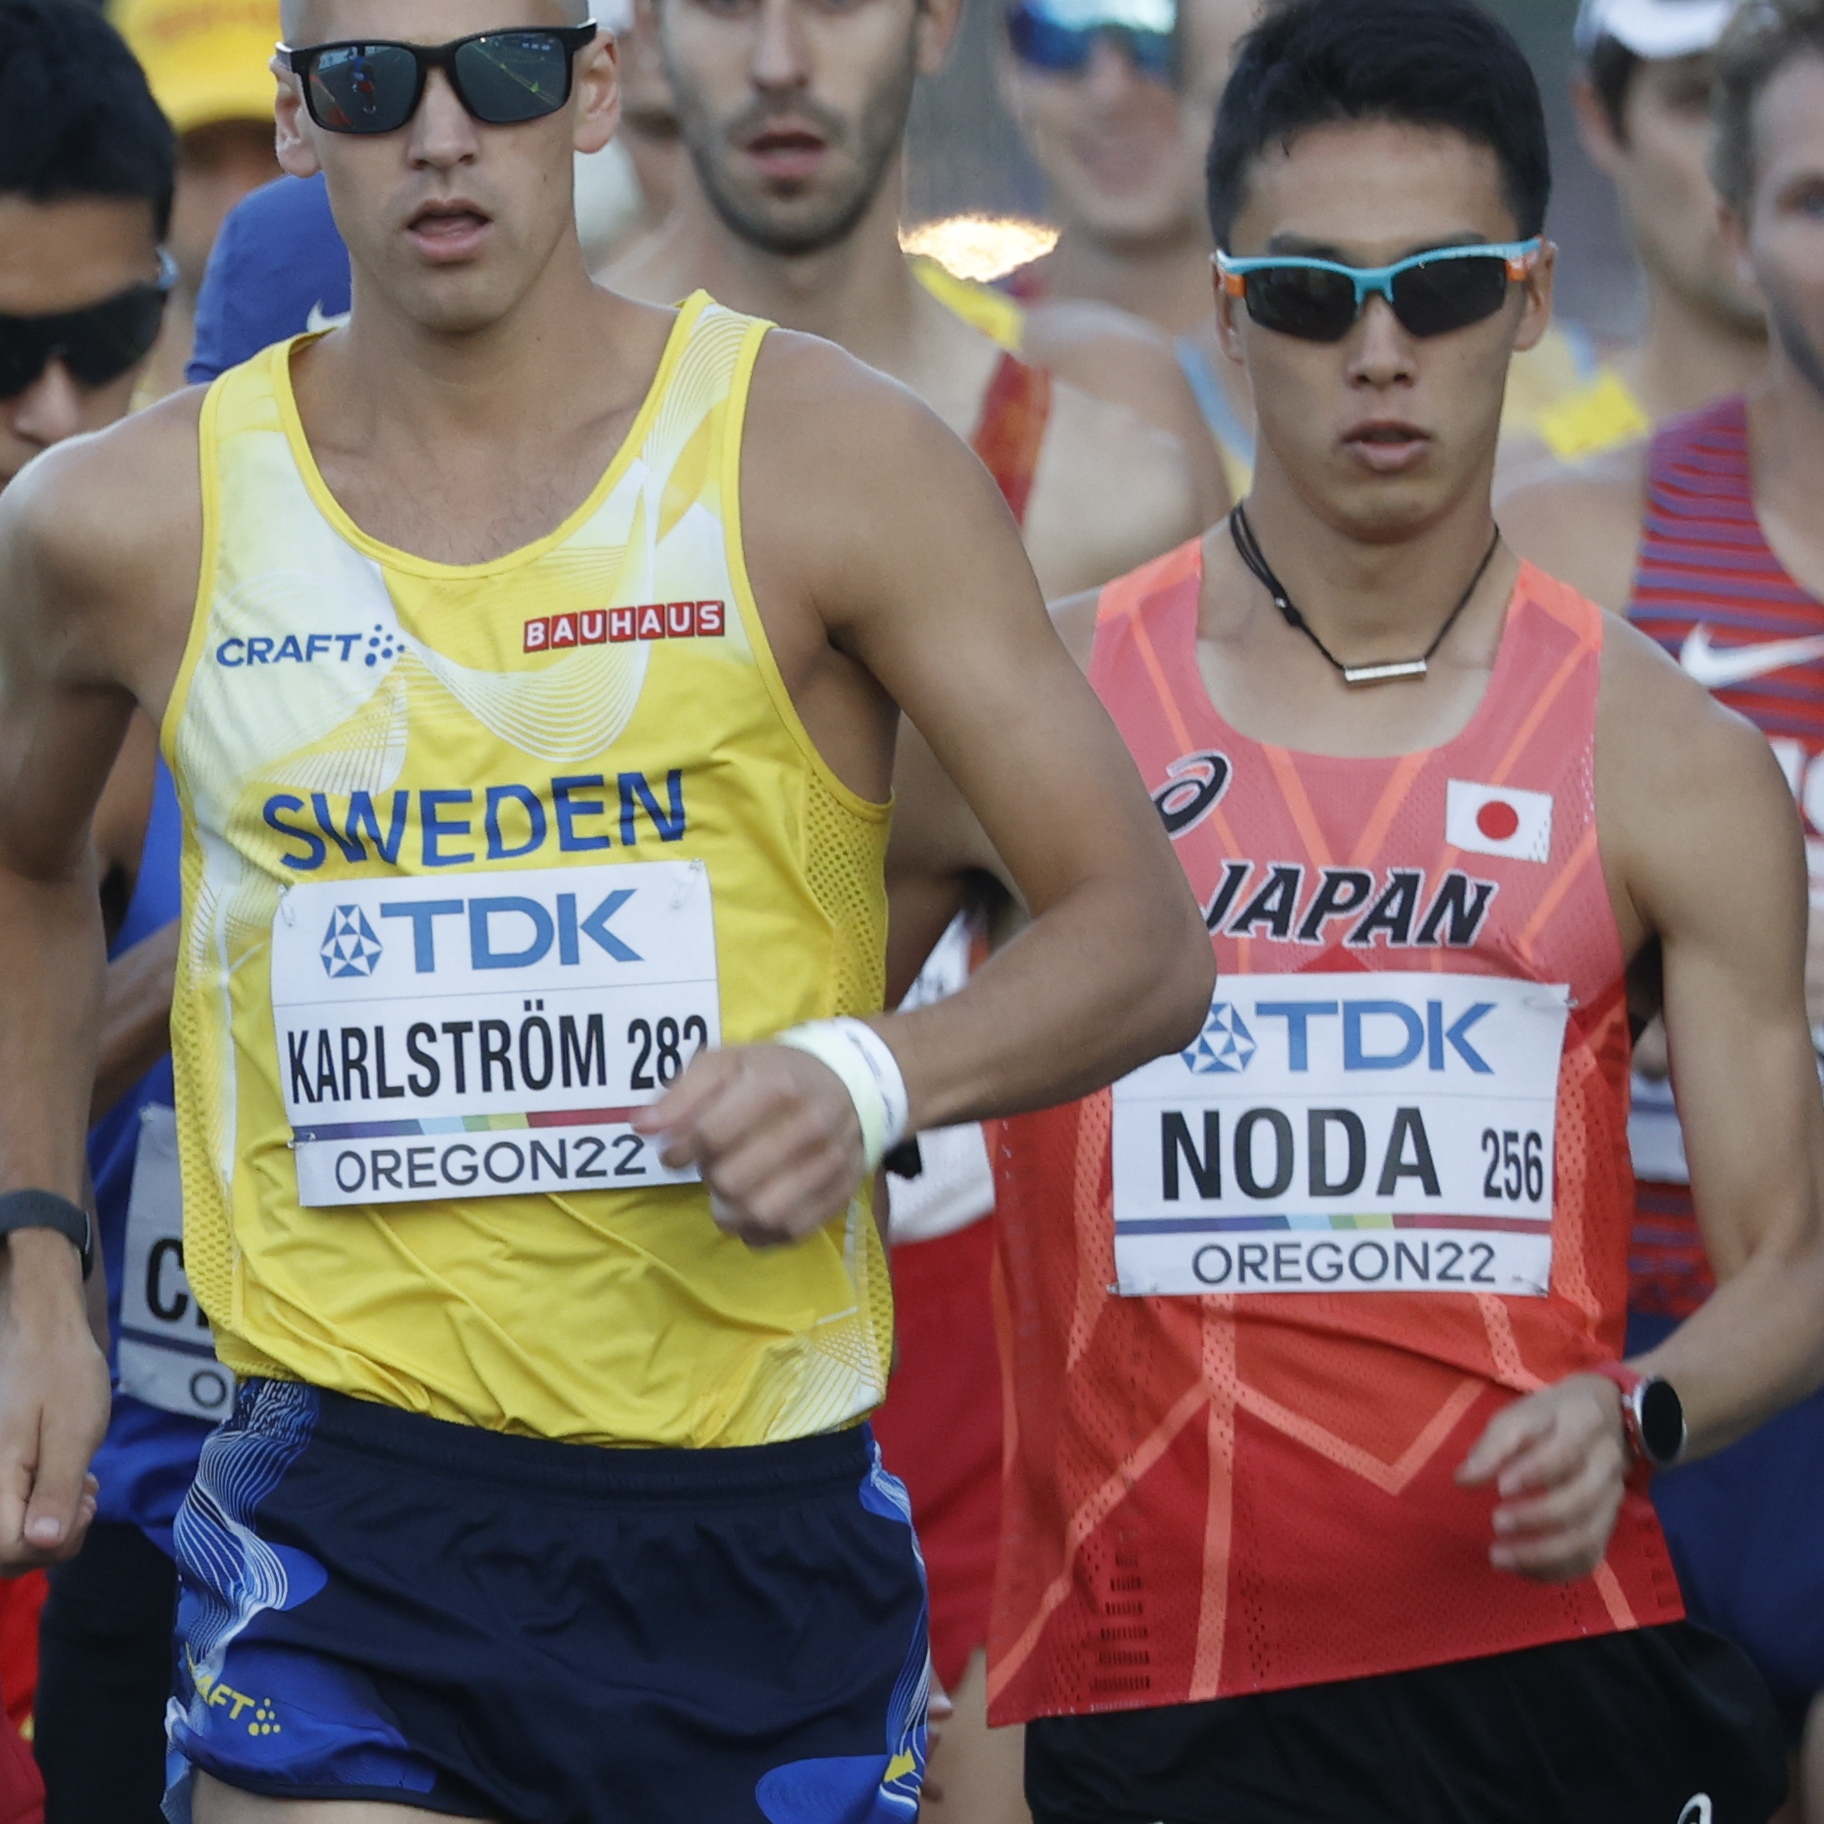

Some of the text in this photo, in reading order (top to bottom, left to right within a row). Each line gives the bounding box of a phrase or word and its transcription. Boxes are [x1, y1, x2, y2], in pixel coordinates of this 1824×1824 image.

[216, 634, 362, 668] CRAFT
[524, 601, 725, 652] BAUHAUS
[263, 768, 687, 870] SWEDEN
[380, 888, 646, 974] TDK
[1206, 859, 1499, 948] JAPAN
[287, 999, 608, 1105] KARLSTRÖM
[1255, 1000, 1495, 1074] TDK
[335, 1134, 647, 1194] OREGON22
[1161, 1107, 1544, 1203] NODA 256
[1192, 1241, 1497, 1285] OREGON22
